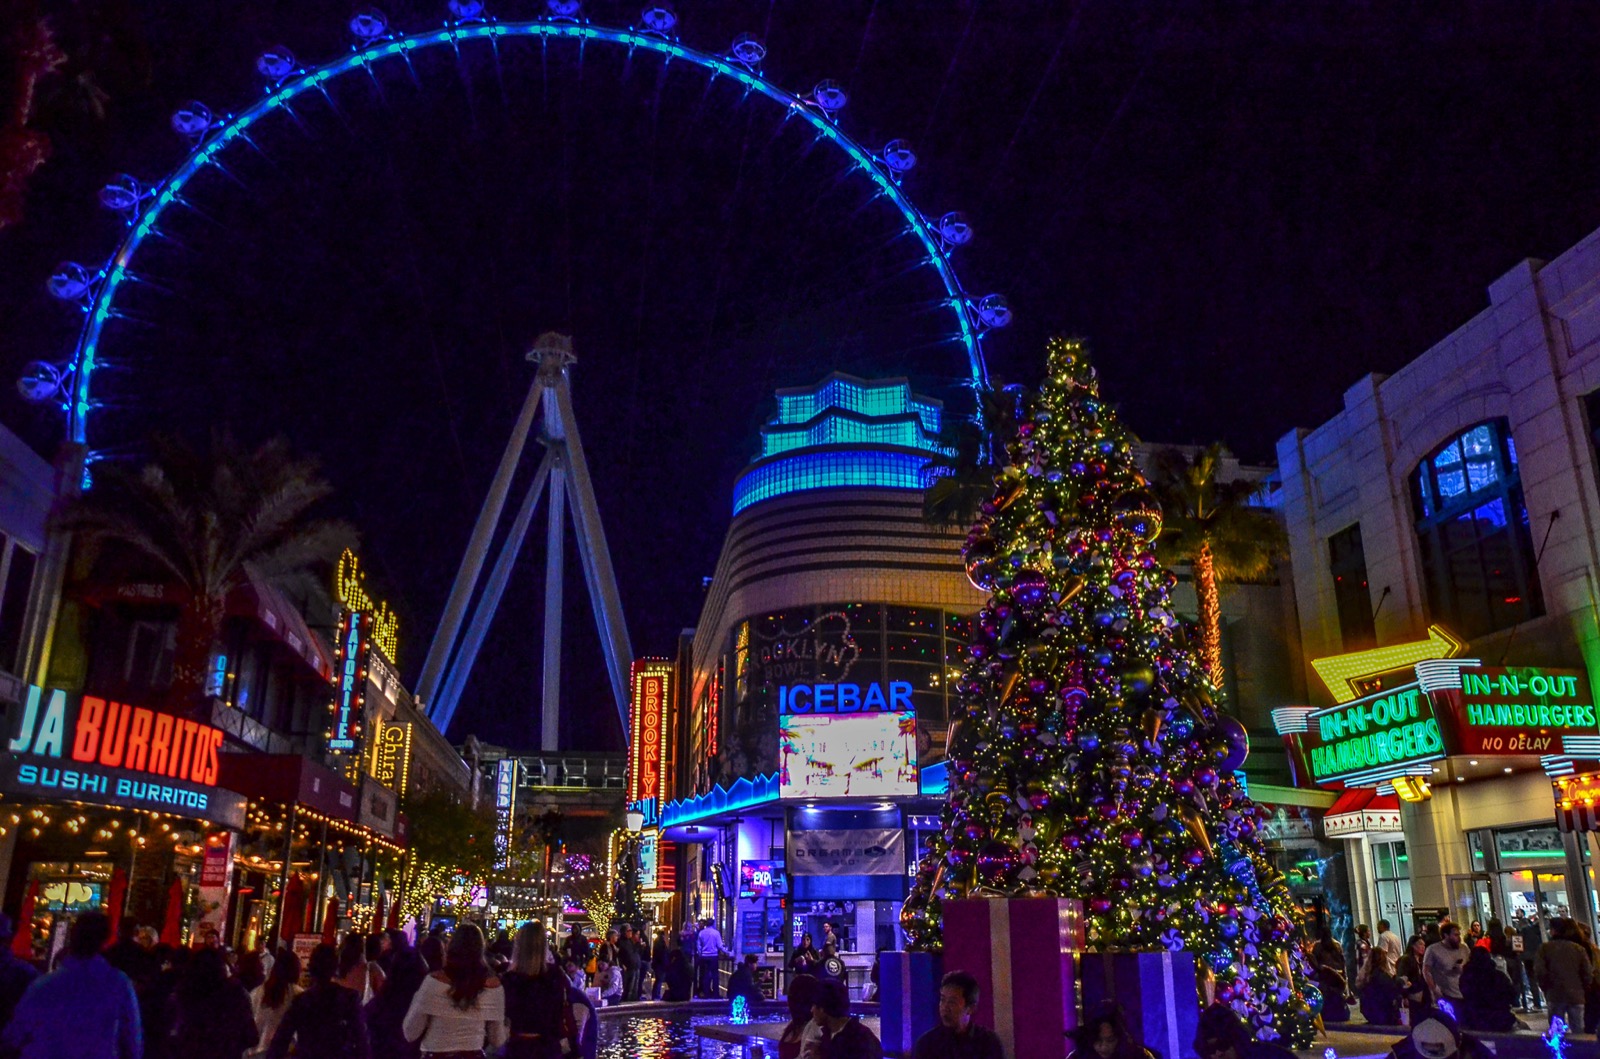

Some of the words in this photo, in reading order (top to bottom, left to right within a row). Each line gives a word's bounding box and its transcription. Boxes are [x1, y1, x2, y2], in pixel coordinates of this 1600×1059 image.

[338, 613, 360, 739] FAVORITE
[779, 682, 914, 714] ICEBAR
[1461, 673, 1578, 697] IN-N-OUT
[1319, 688, 1420, 741] IN-N-OUT
[1466, 703, 1596, 728] HAMBURGERS
[72, 695, 224, 787] BURRITOS
[1311, 718, 1441, 777] HAMBURGERS
[1482, 737, 1502, 750] NO
[1508, 736, 1552, 750] DELAY
[18, 765, 108, 793] SUSHI
[117, 779, 208, 810] BURRITOS
[500, 760, 511, 806] YARD
